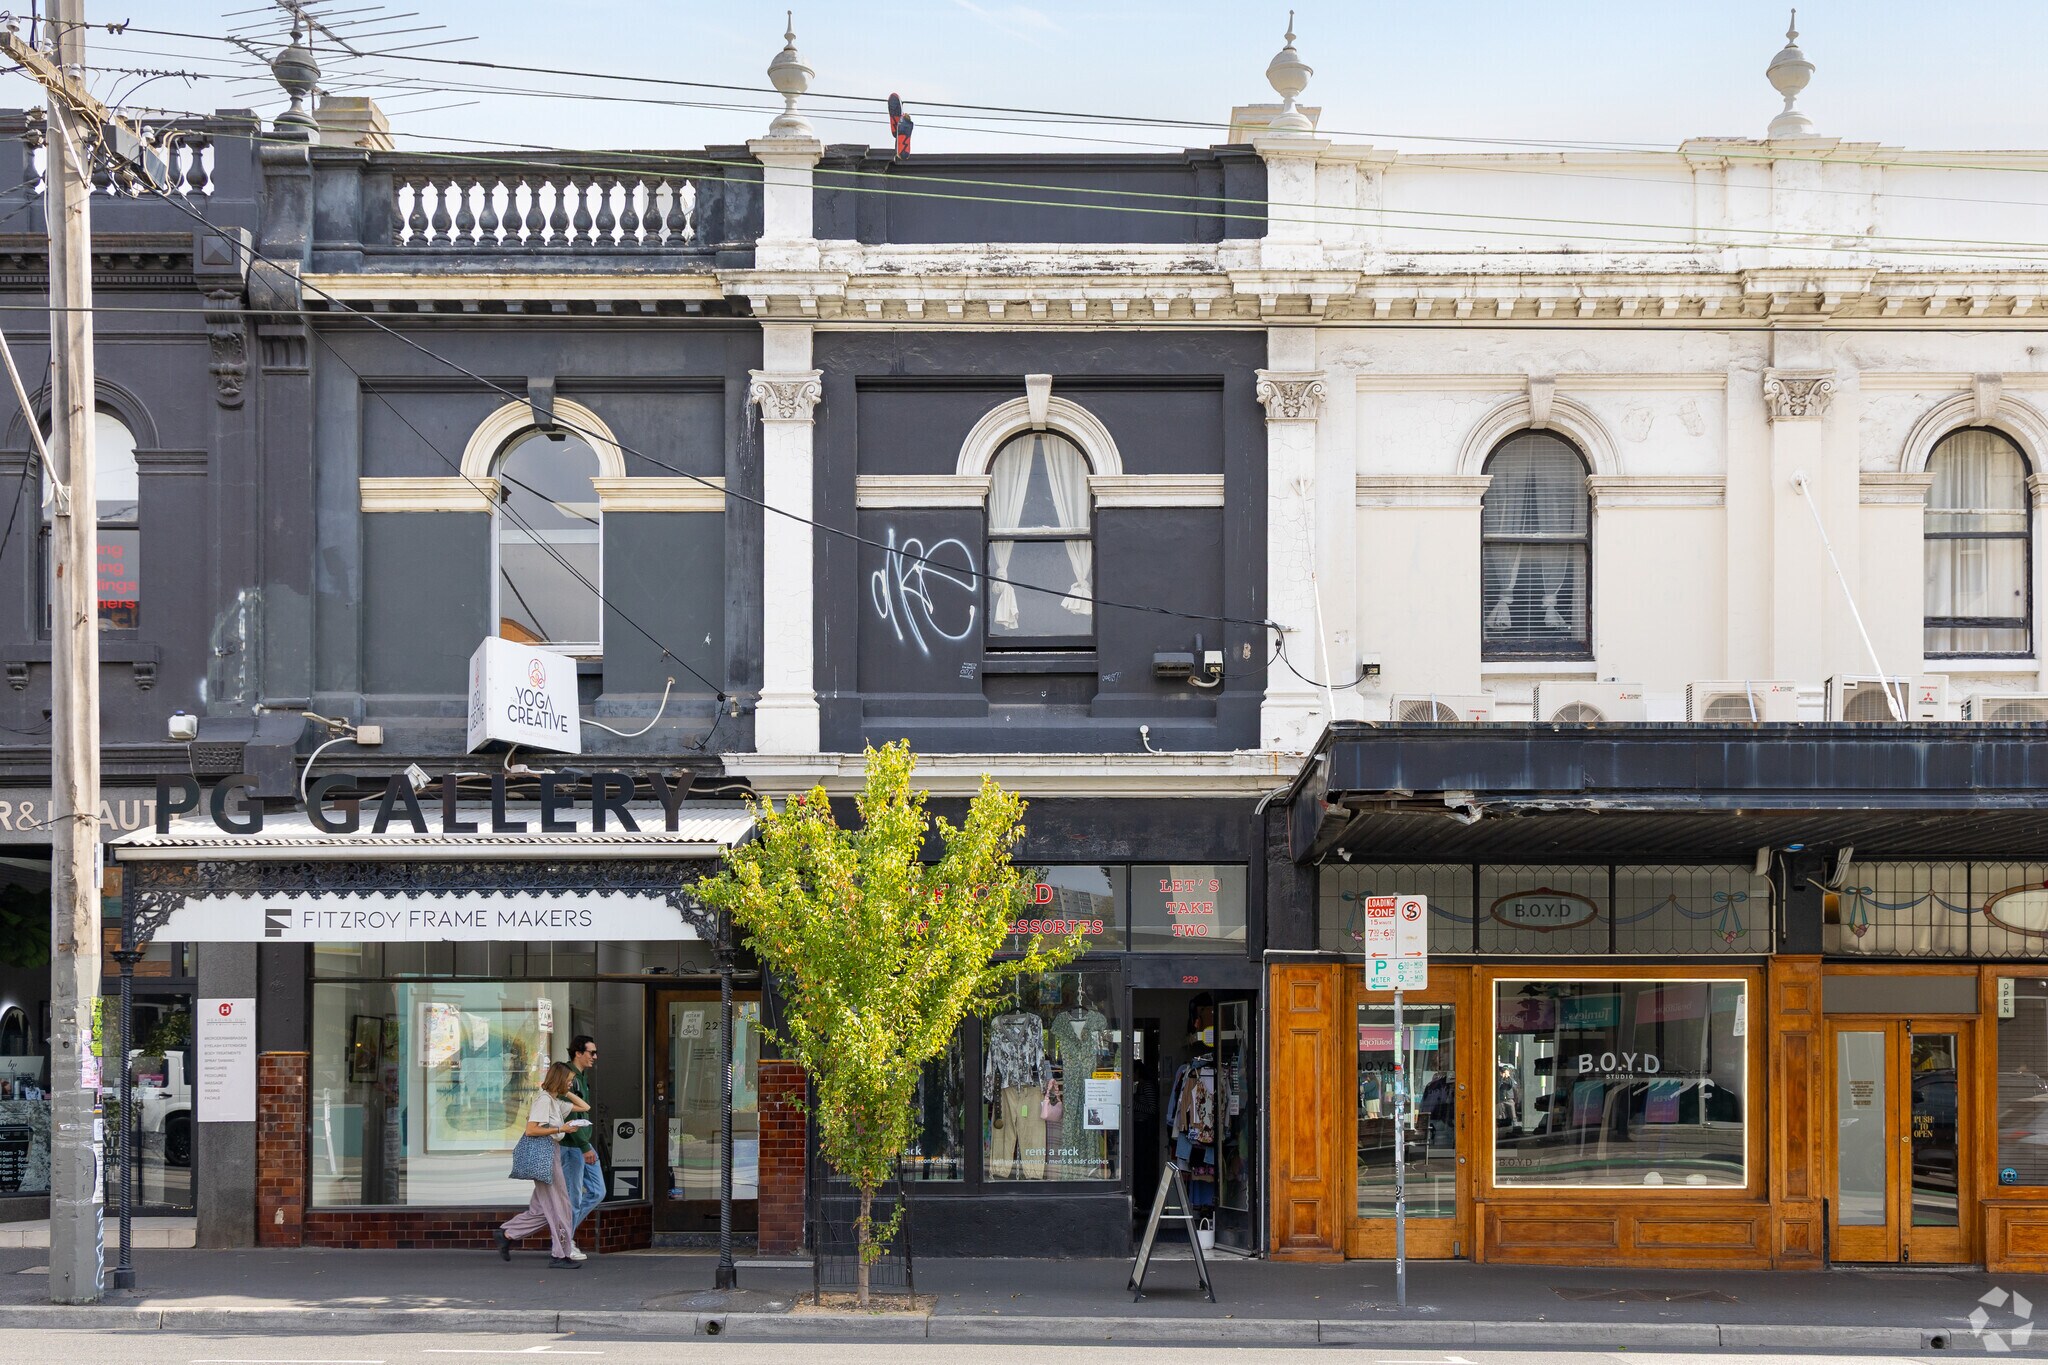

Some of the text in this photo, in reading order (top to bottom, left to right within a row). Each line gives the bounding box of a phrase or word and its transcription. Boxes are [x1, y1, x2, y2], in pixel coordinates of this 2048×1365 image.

[515, 686, 552, 710] YOGA
[507, 704, 568, 733] CREATIVE
[156, 772, 697, 834] PG GALLERY
[1160, 879, 1220, 893] LET'S
[1166, 901, 1214, 915] TAKE
[1368, 899, 1395, 908] LOADING
[1515, 904, 1571, 917] B.O.Y.D
[304, 910, 592, 928] FITZROY FRAME MAKERS
[1368, 908, 1395, 917] ZONE
[1172, 923, 1209, 937] TWO
[1375, 960, 1387, 975] P
[1182, 975, 1199, 983] 229
[1578, 1052, 1660, 1074] B.O.Y.D
[1914, 1130, 1933, 1138] OPEN
[1025, 1146, 1079, 1156] rent a rack
